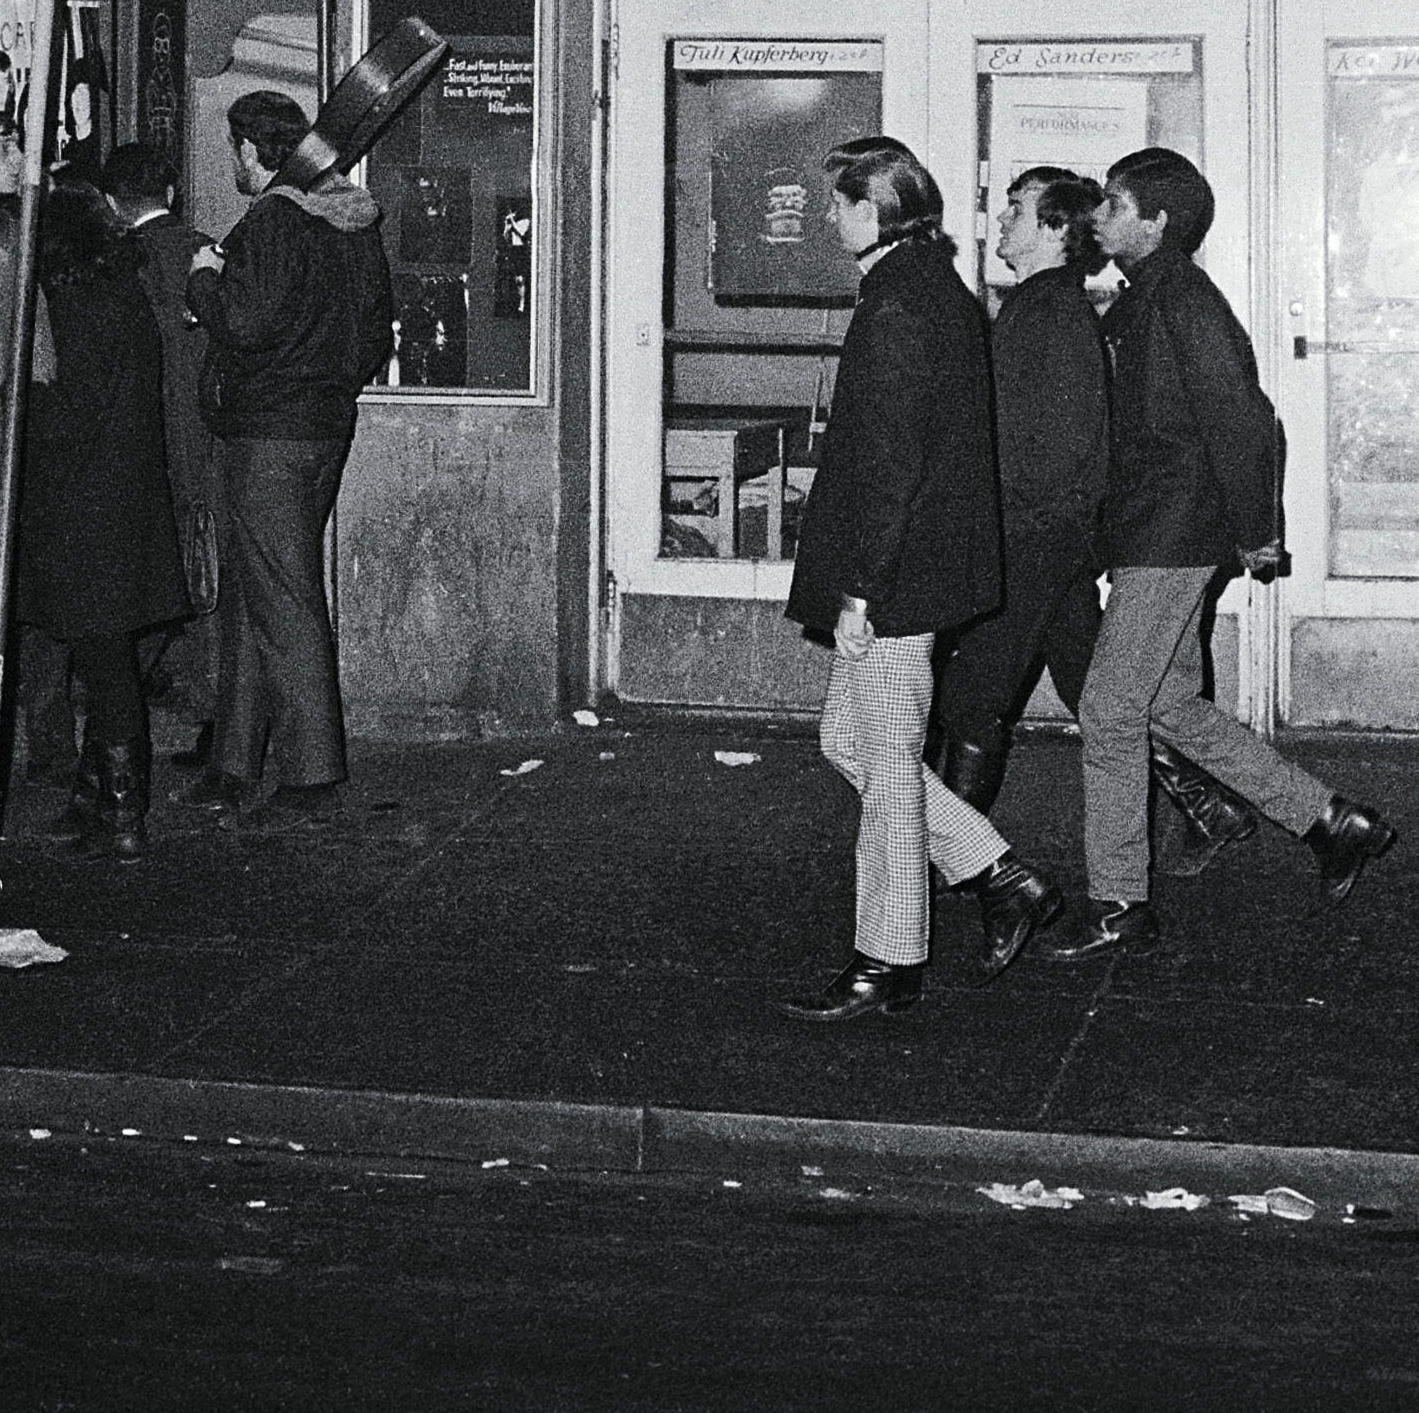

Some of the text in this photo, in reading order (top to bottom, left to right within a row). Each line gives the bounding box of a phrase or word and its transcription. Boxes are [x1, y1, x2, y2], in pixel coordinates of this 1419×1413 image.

[679, 43, 725, 64] Tuli
[727, 43, 828, 66] Kupferberg
[988, 45, 1022, 70] Ed
[1035, 46, 1134, 69] Sanders
